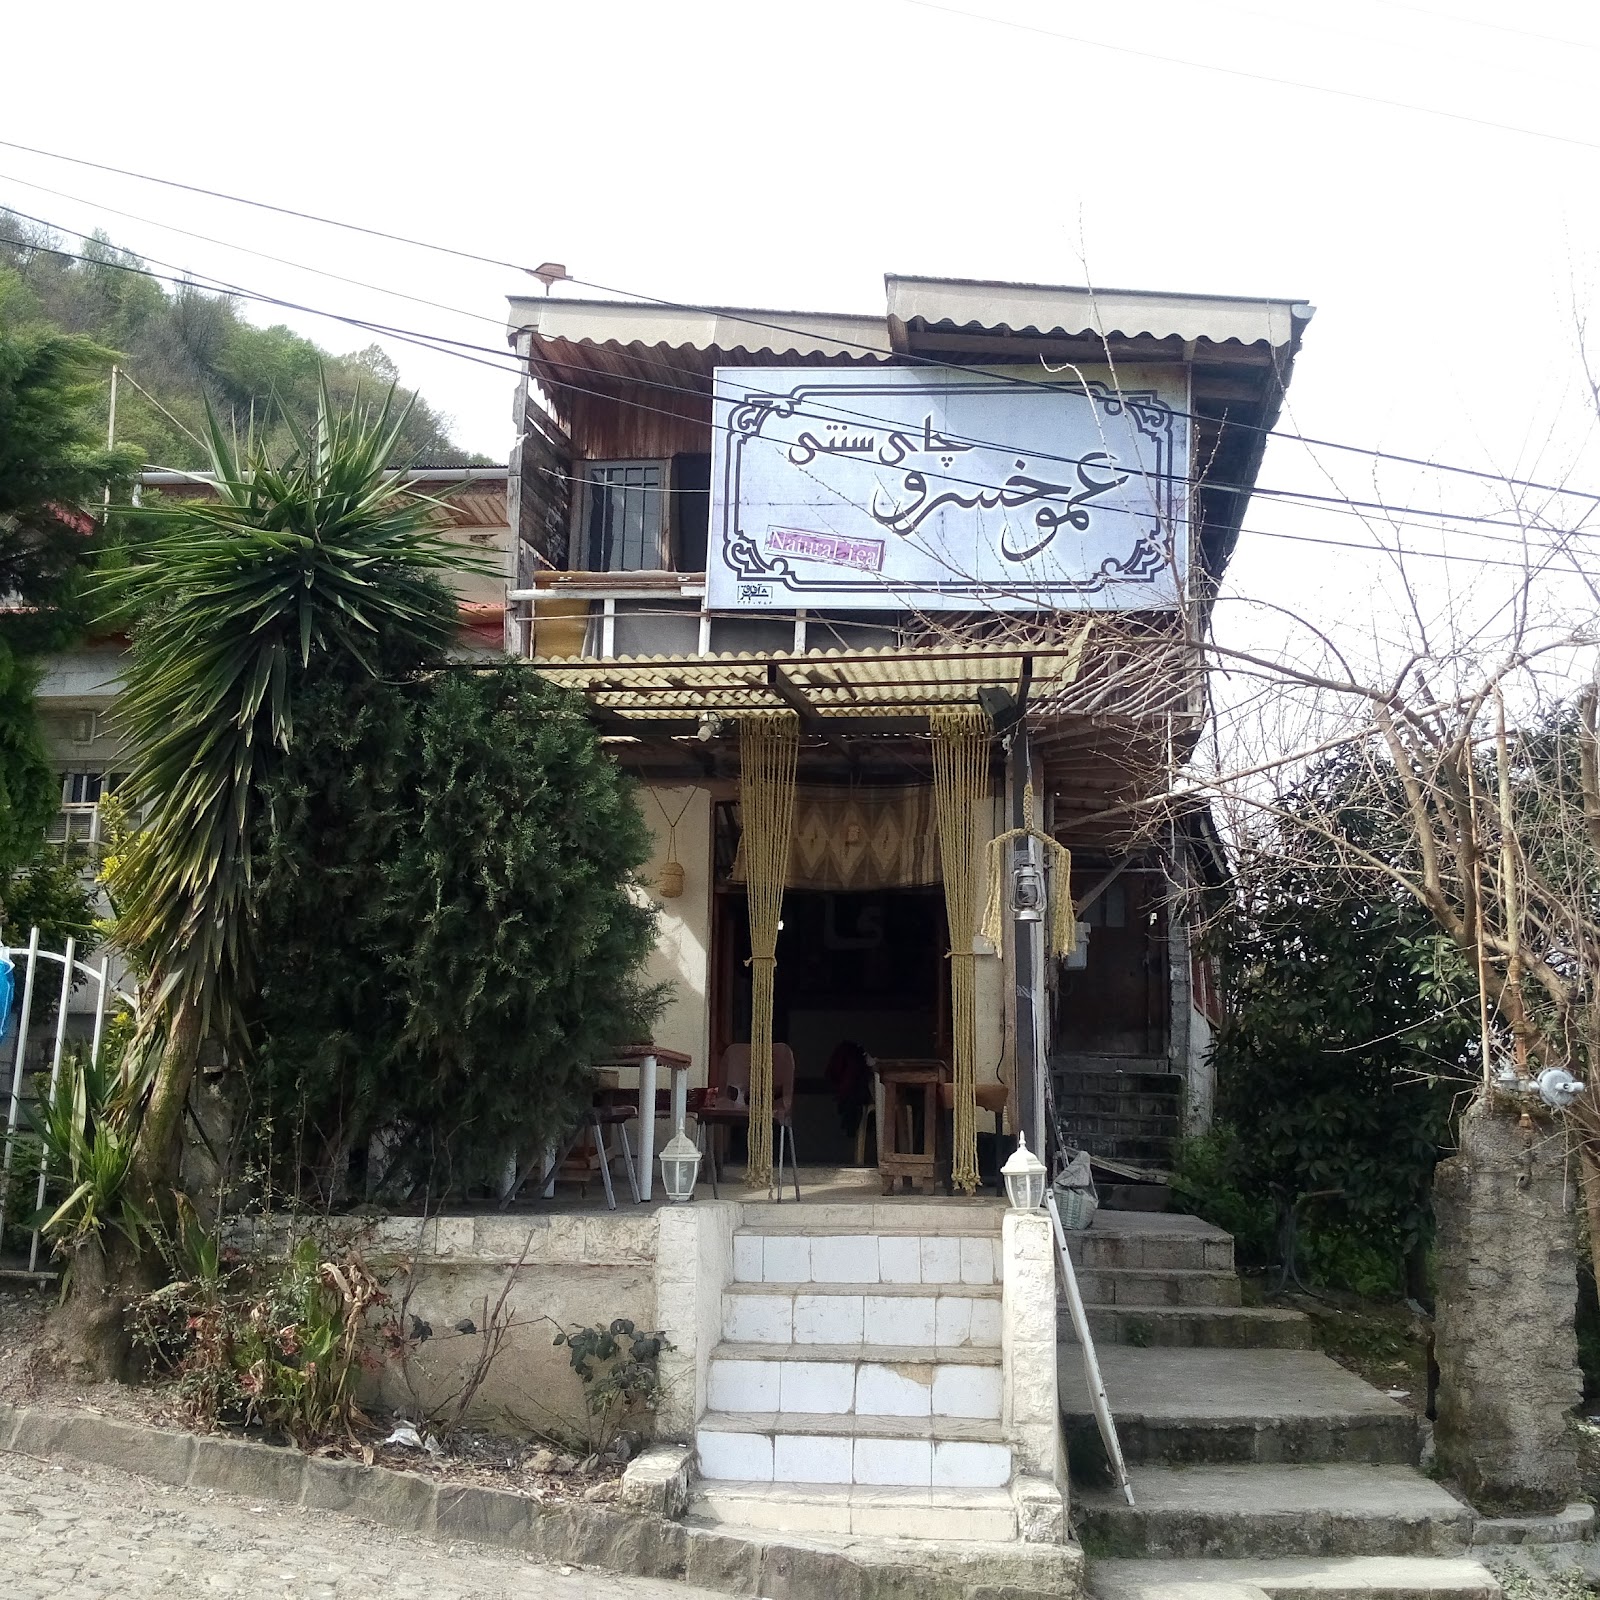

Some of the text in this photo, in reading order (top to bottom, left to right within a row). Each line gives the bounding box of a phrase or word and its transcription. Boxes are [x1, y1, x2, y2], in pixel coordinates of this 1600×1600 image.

[788, 415, 976, 468] چای سنتی
[873, 452, 1129, 562] عمو خسرو
[770, 530, 838, 559] Natural
